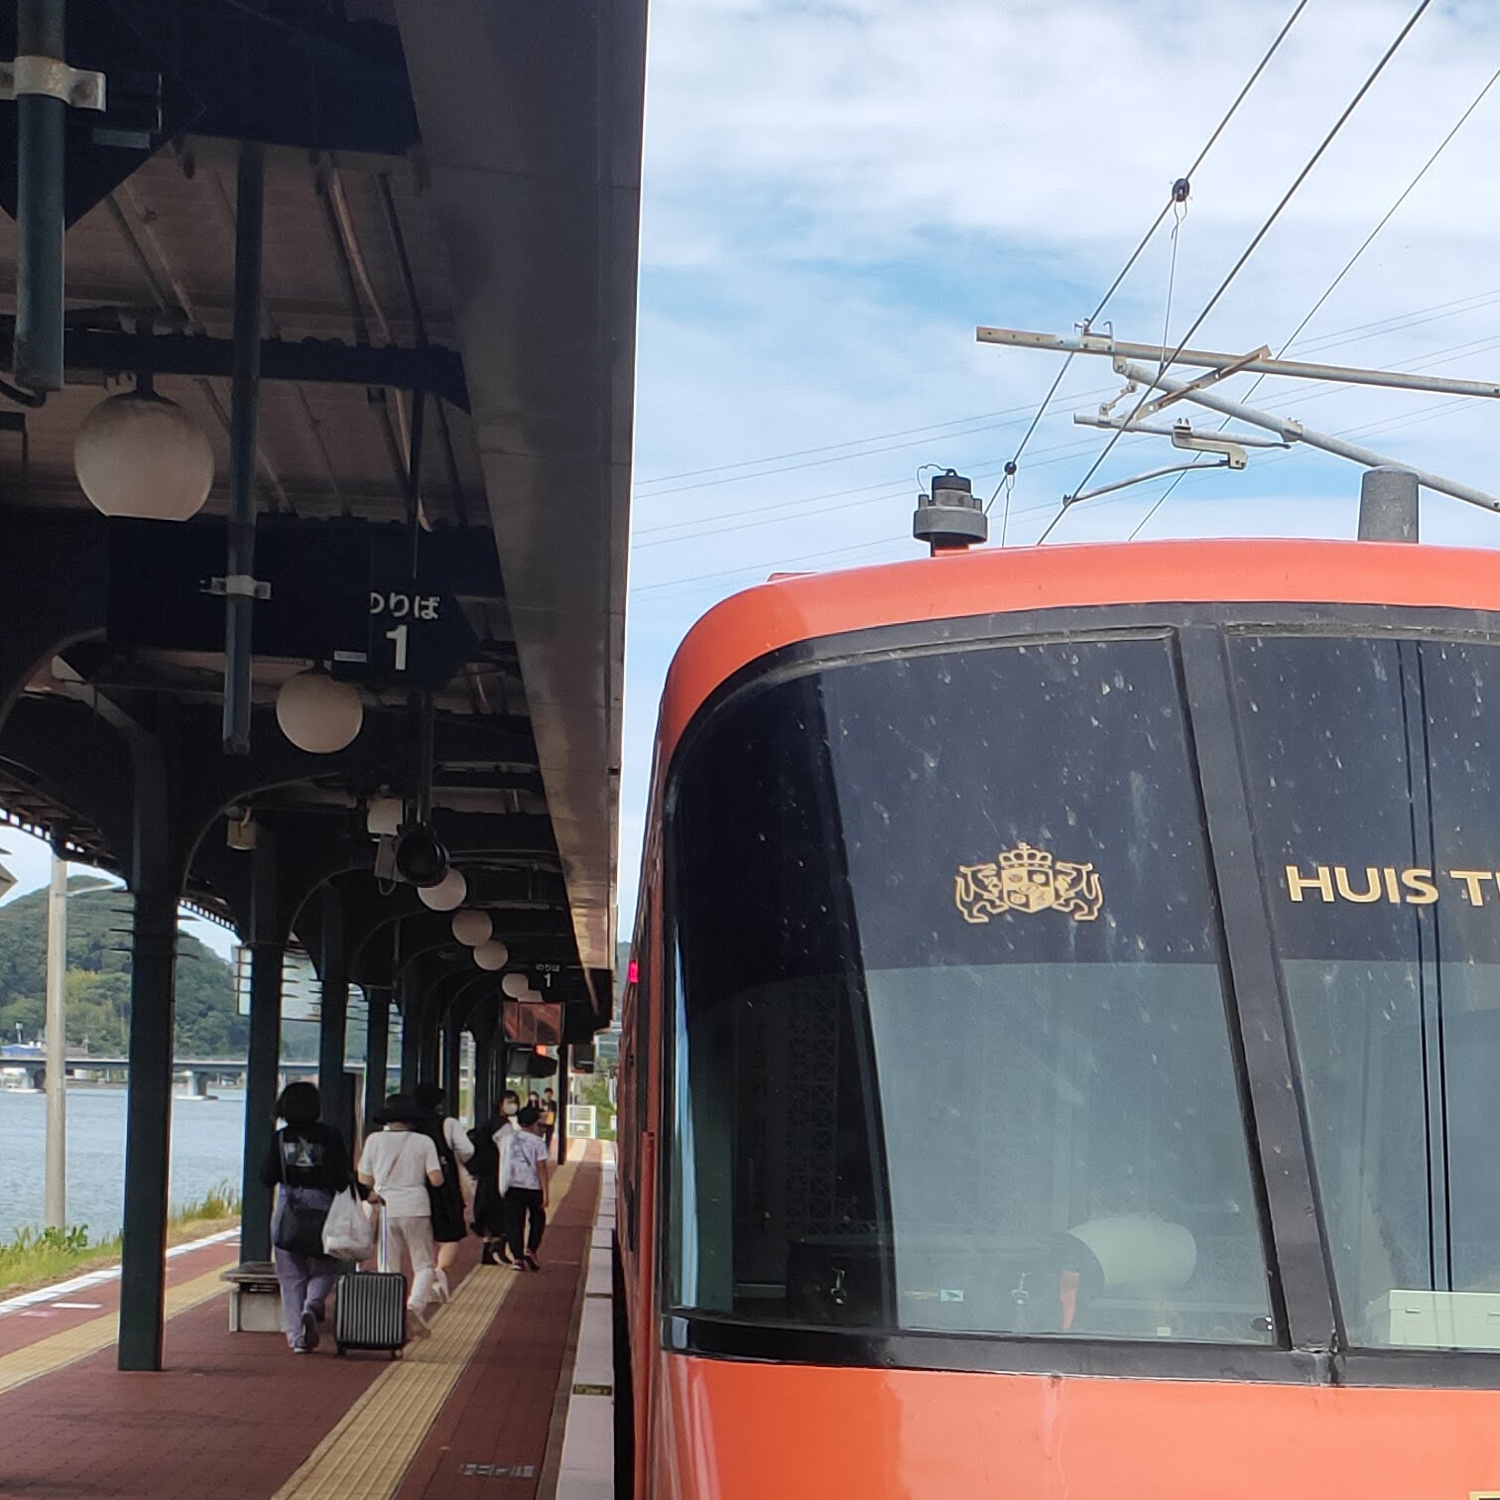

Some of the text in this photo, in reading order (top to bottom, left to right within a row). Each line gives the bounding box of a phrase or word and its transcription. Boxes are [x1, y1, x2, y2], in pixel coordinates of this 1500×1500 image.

[386, 625, 407, 670] 1
[1285, 865, 1439, 905] HUIS
[544, 973, 551, 988] 1
